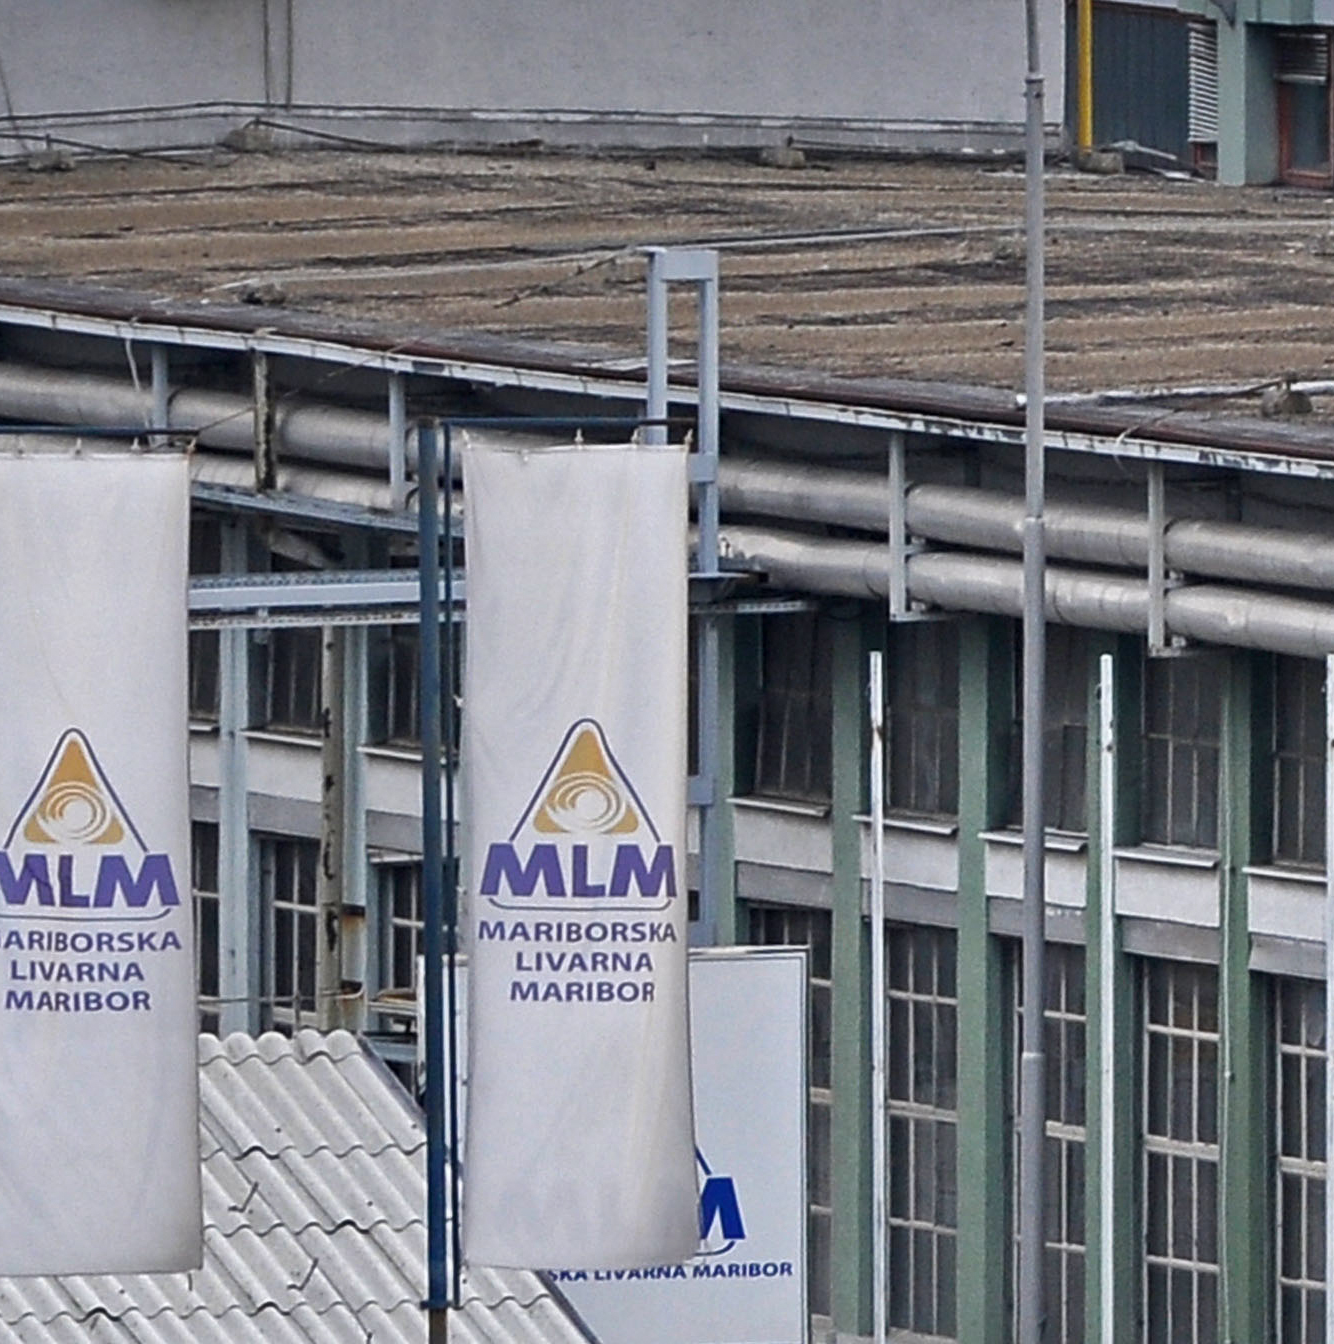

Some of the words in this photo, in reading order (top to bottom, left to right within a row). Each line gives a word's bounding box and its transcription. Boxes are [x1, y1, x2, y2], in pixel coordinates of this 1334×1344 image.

[479, 842, 678, 898] MLM
[478, 920, 678, 943] MARIBORSKA
[10, 959, 145, 983] LIVARNA
[515, 951, 654, 973] LIVARNA
[4, 989, 152, 1012] MARIBOR
[509, 980, 656, 1003] MARIBOR
[692, 1261, 794, 1279] MARIBOR
